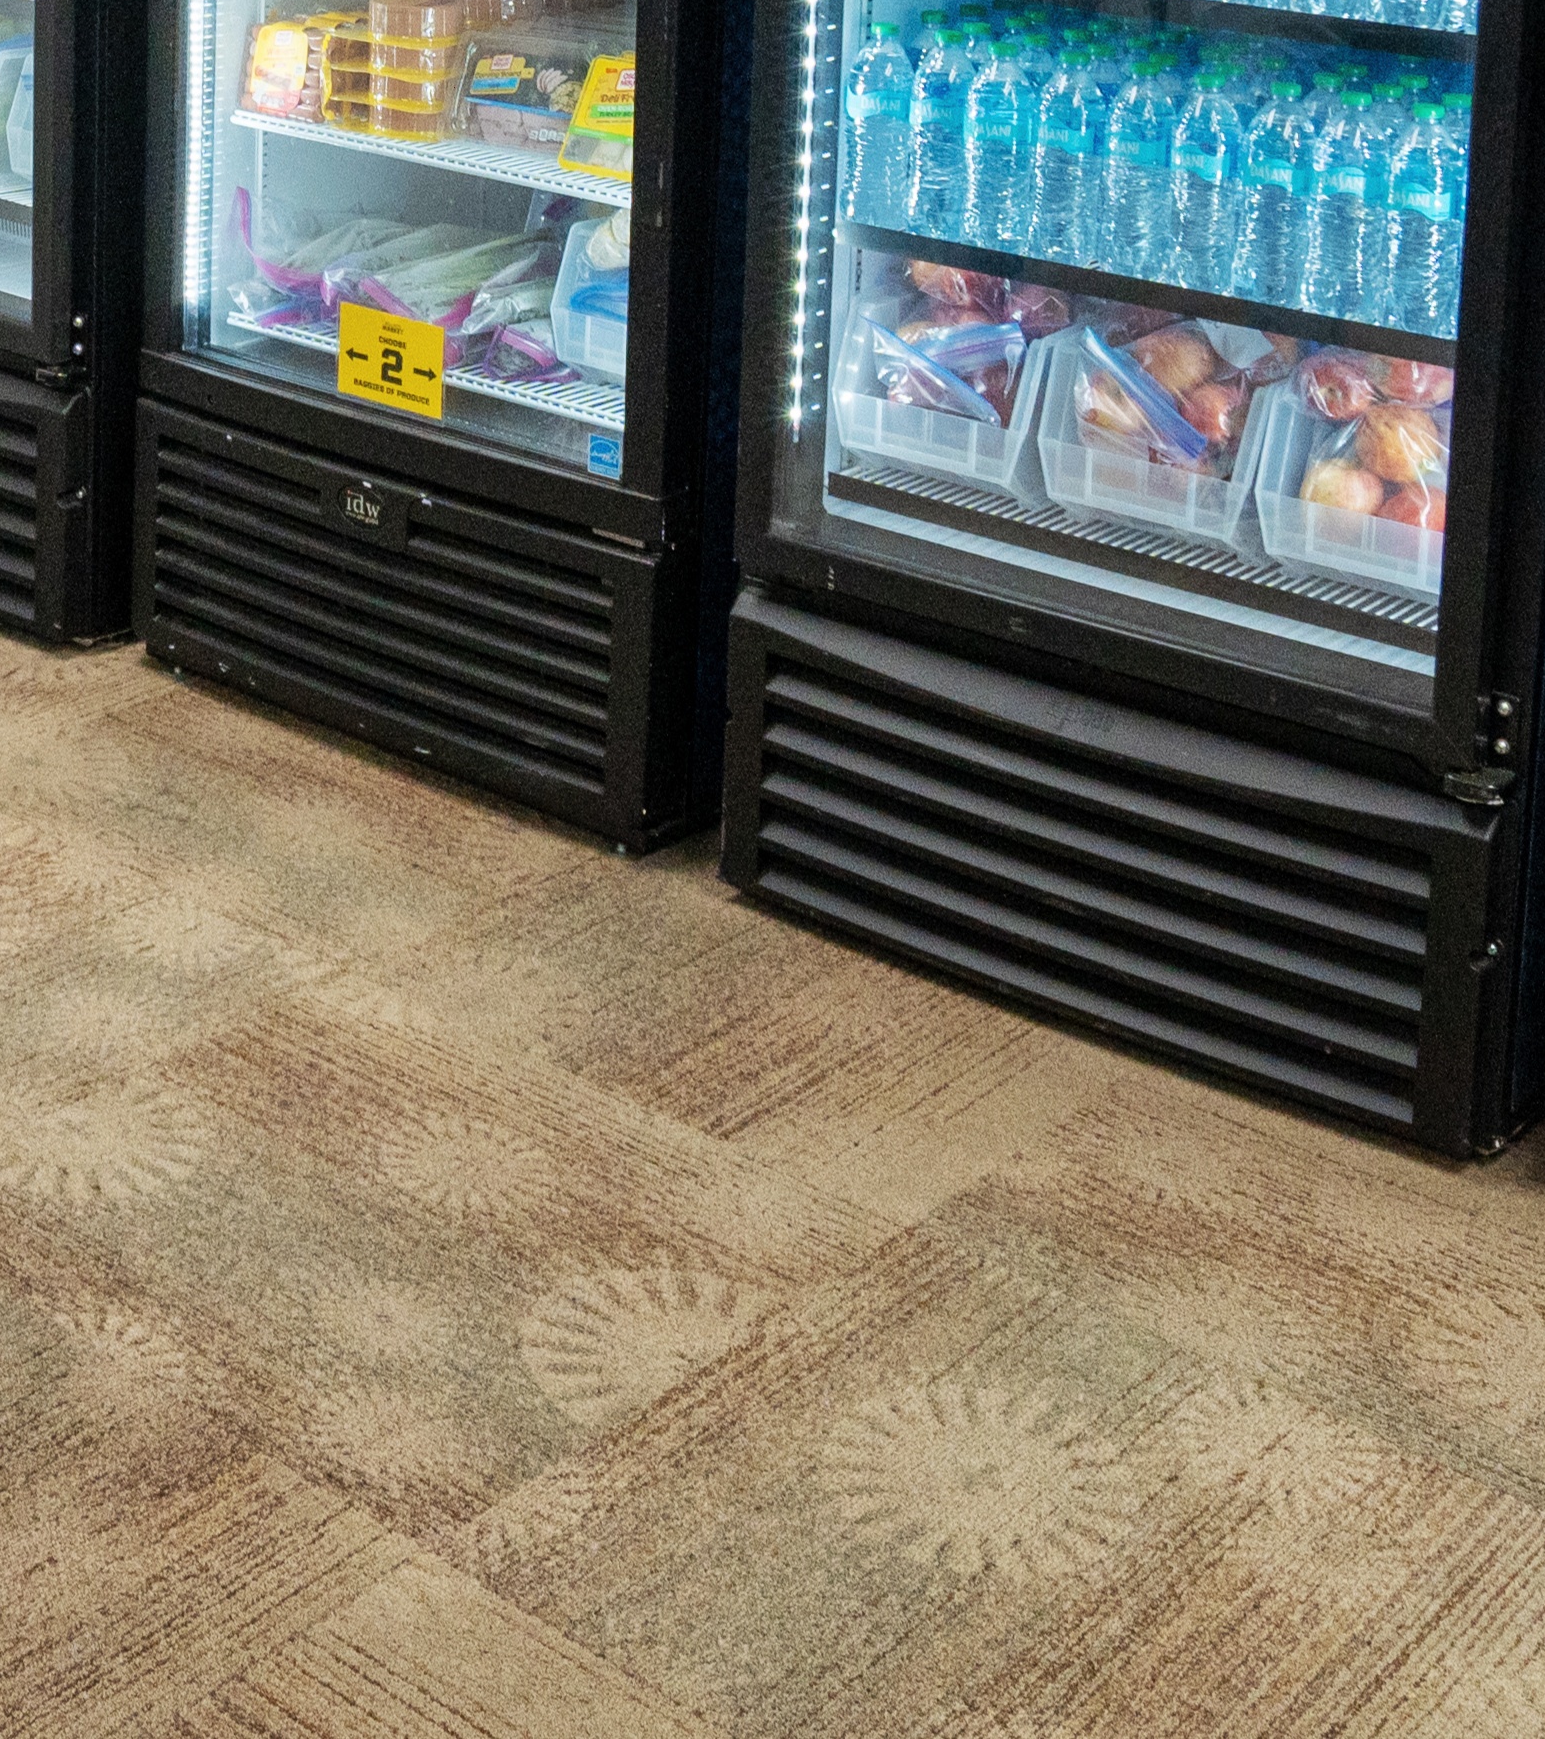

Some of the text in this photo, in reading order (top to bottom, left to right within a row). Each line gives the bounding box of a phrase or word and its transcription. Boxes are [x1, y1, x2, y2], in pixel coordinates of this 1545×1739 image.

[378, 335, 407, 350] CHOOSE
[381, 347, 403, 386] 2
[353, 378, 430, 406] BAGGIES OF PRODUCE
